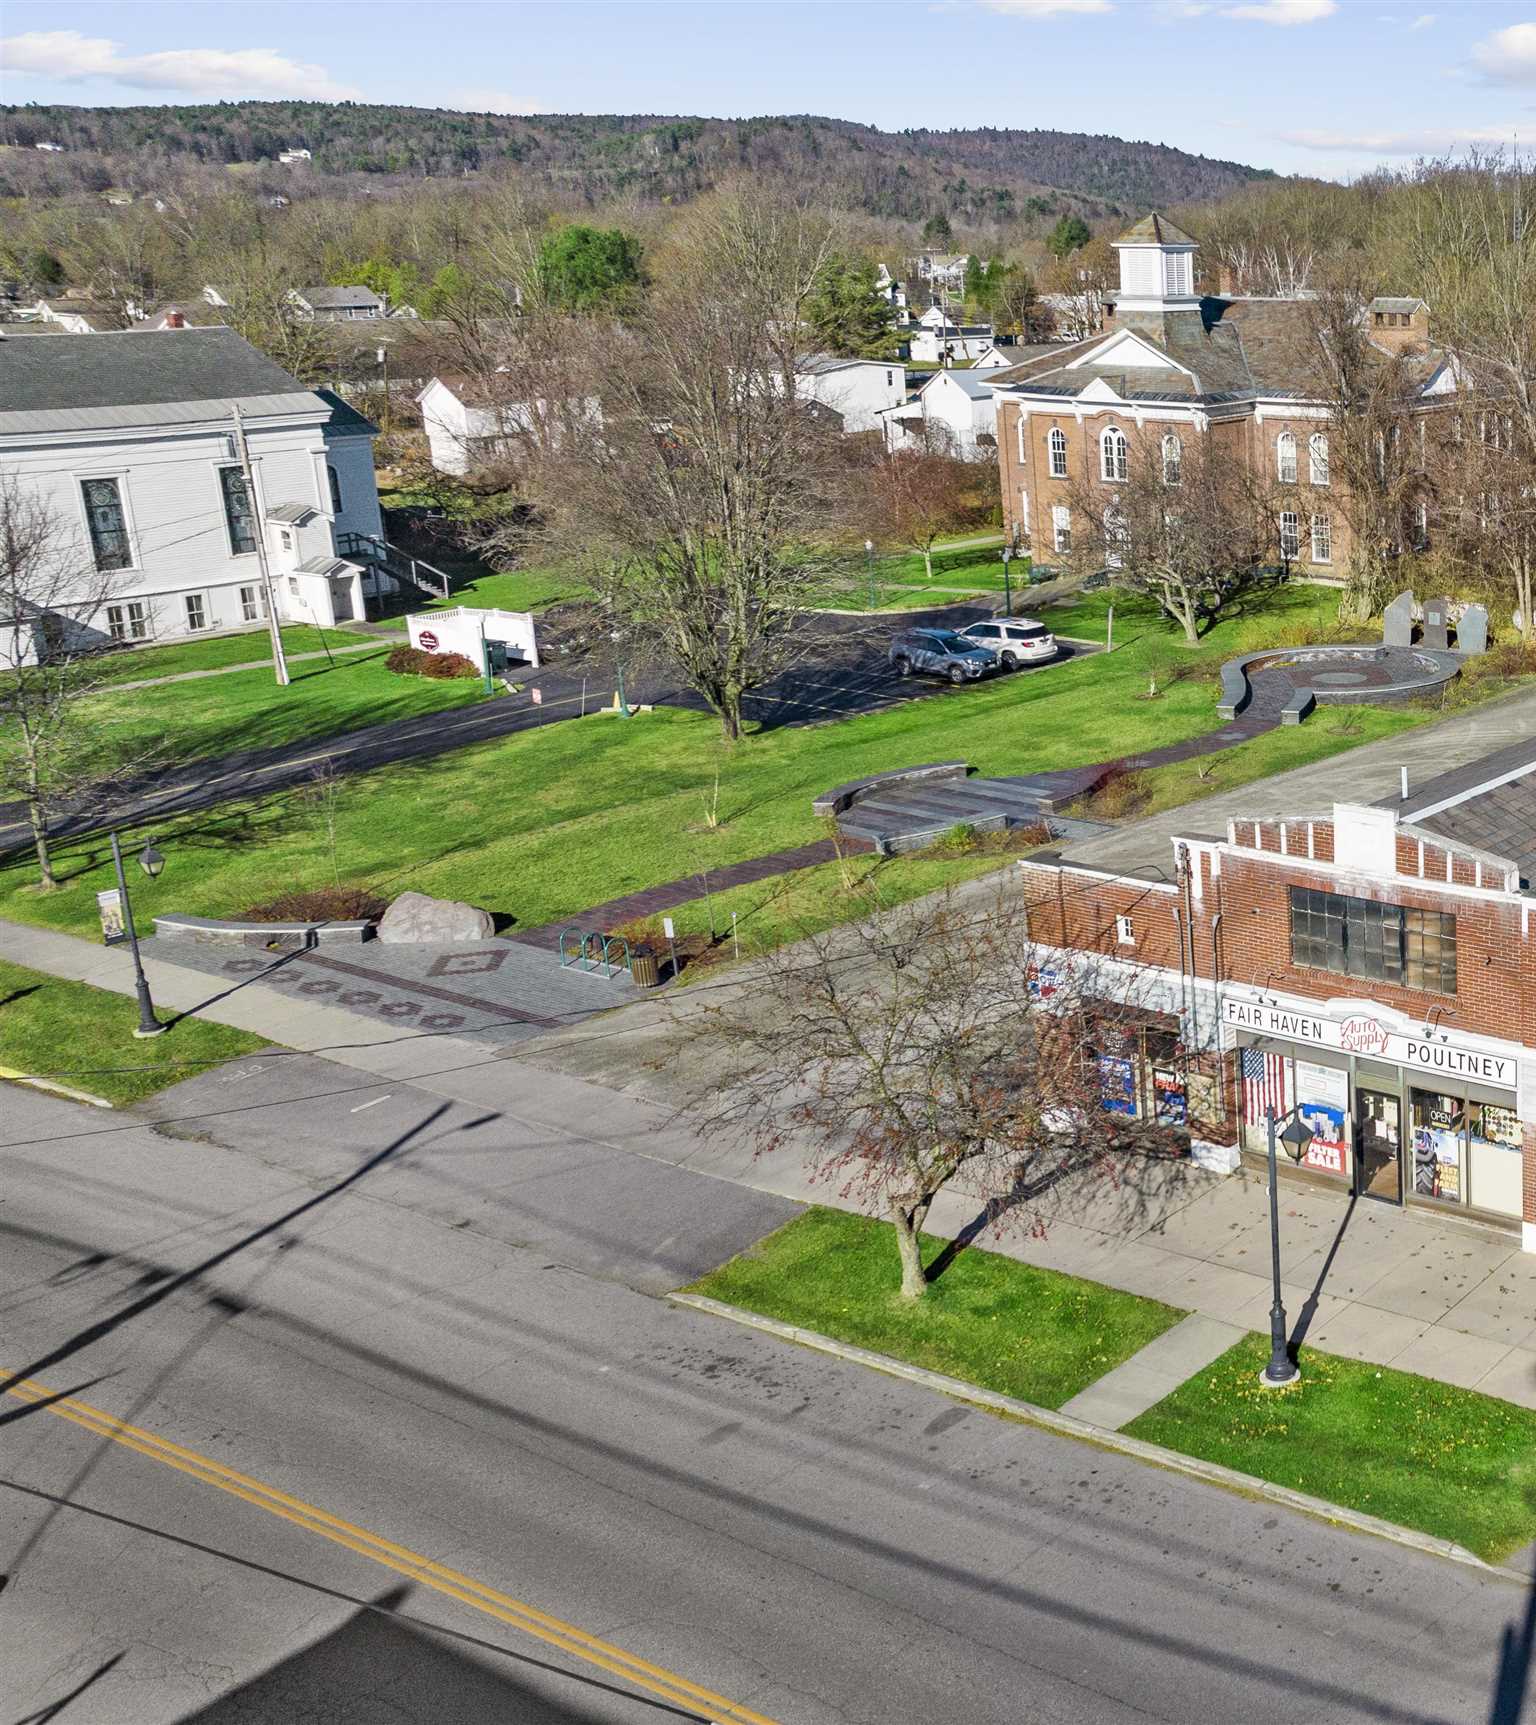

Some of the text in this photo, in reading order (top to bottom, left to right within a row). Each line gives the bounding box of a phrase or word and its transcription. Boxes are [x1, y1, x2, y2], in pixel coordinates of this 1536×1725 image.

[1229, 1003, 1322, 1039] FAIR HAVEN
[1408, 1042, 1505, 1078] POULTNEY
[1430, 1110, 1451, 1124] OPEN
[1309, 1142, 1341, 1159] FILTER
[1307, 1151, 1341, 1170] SALE
